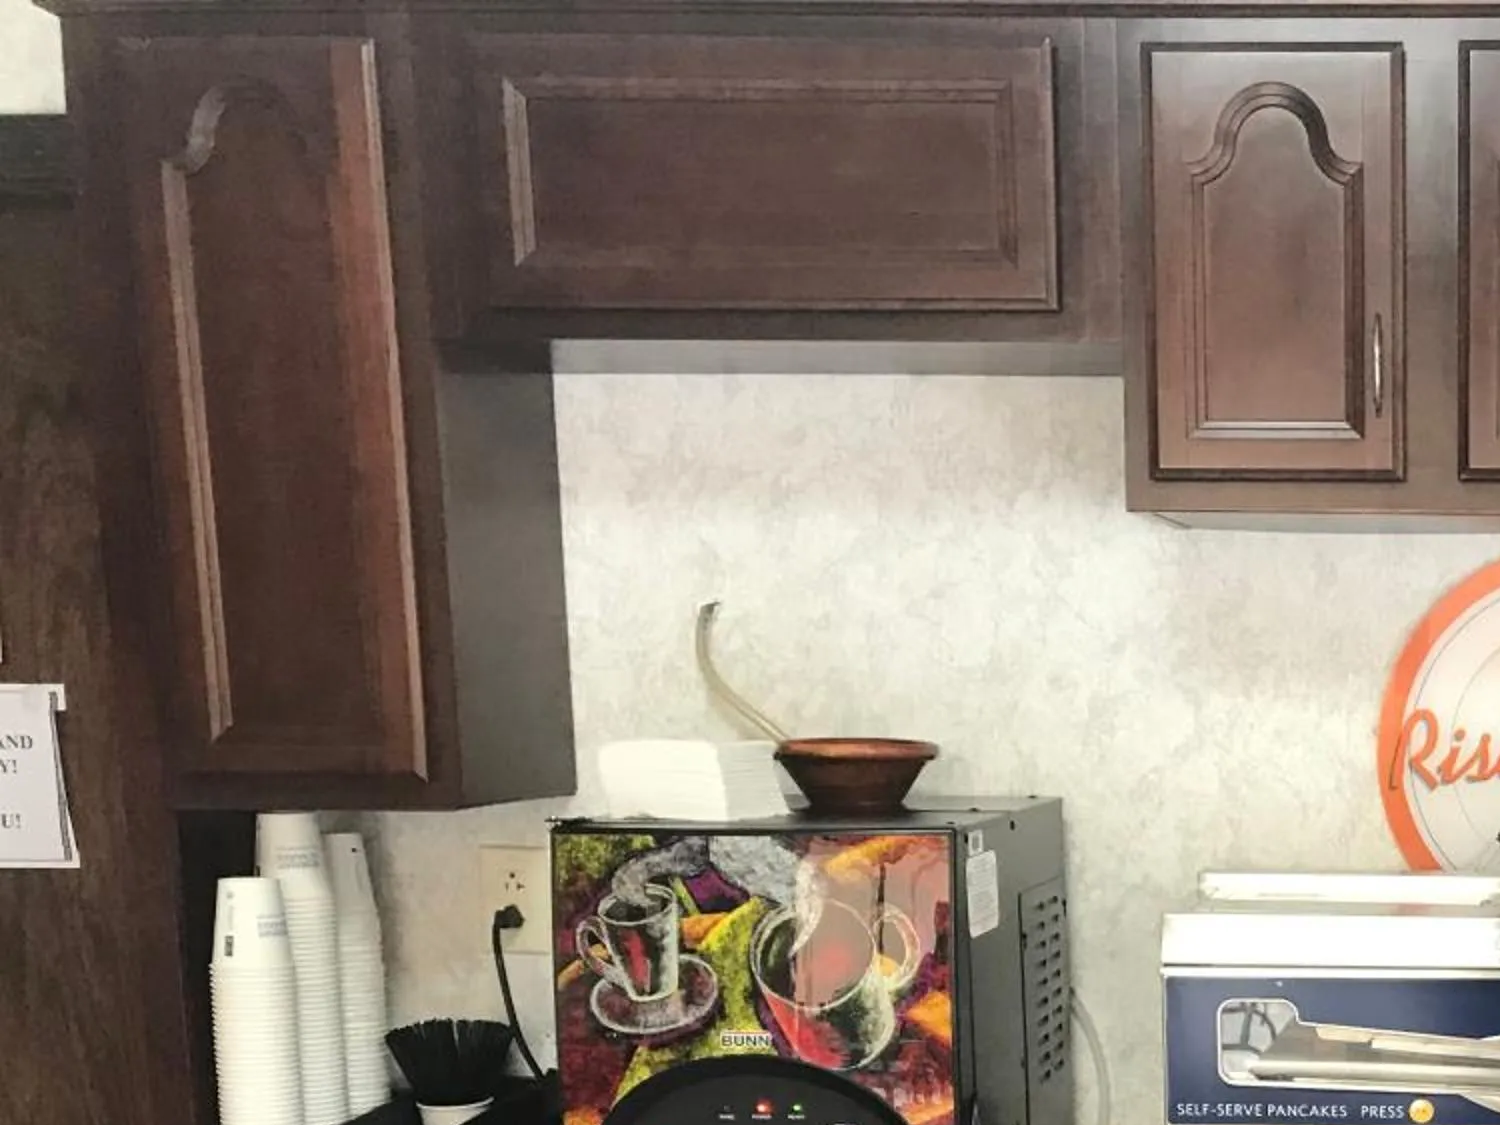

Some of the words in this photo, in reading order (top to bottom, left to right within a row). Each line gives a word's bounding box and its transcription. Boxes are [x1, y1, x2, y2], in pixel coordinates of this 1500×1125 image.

[721, 1035, 769, 1047] BUNN
[1176, 1103, 1262, 1117] SELF-SERVE
[1267, 1104, 1348, 1118] PANCAKES
[1360, 1105, 1404, 1119] PRESS
